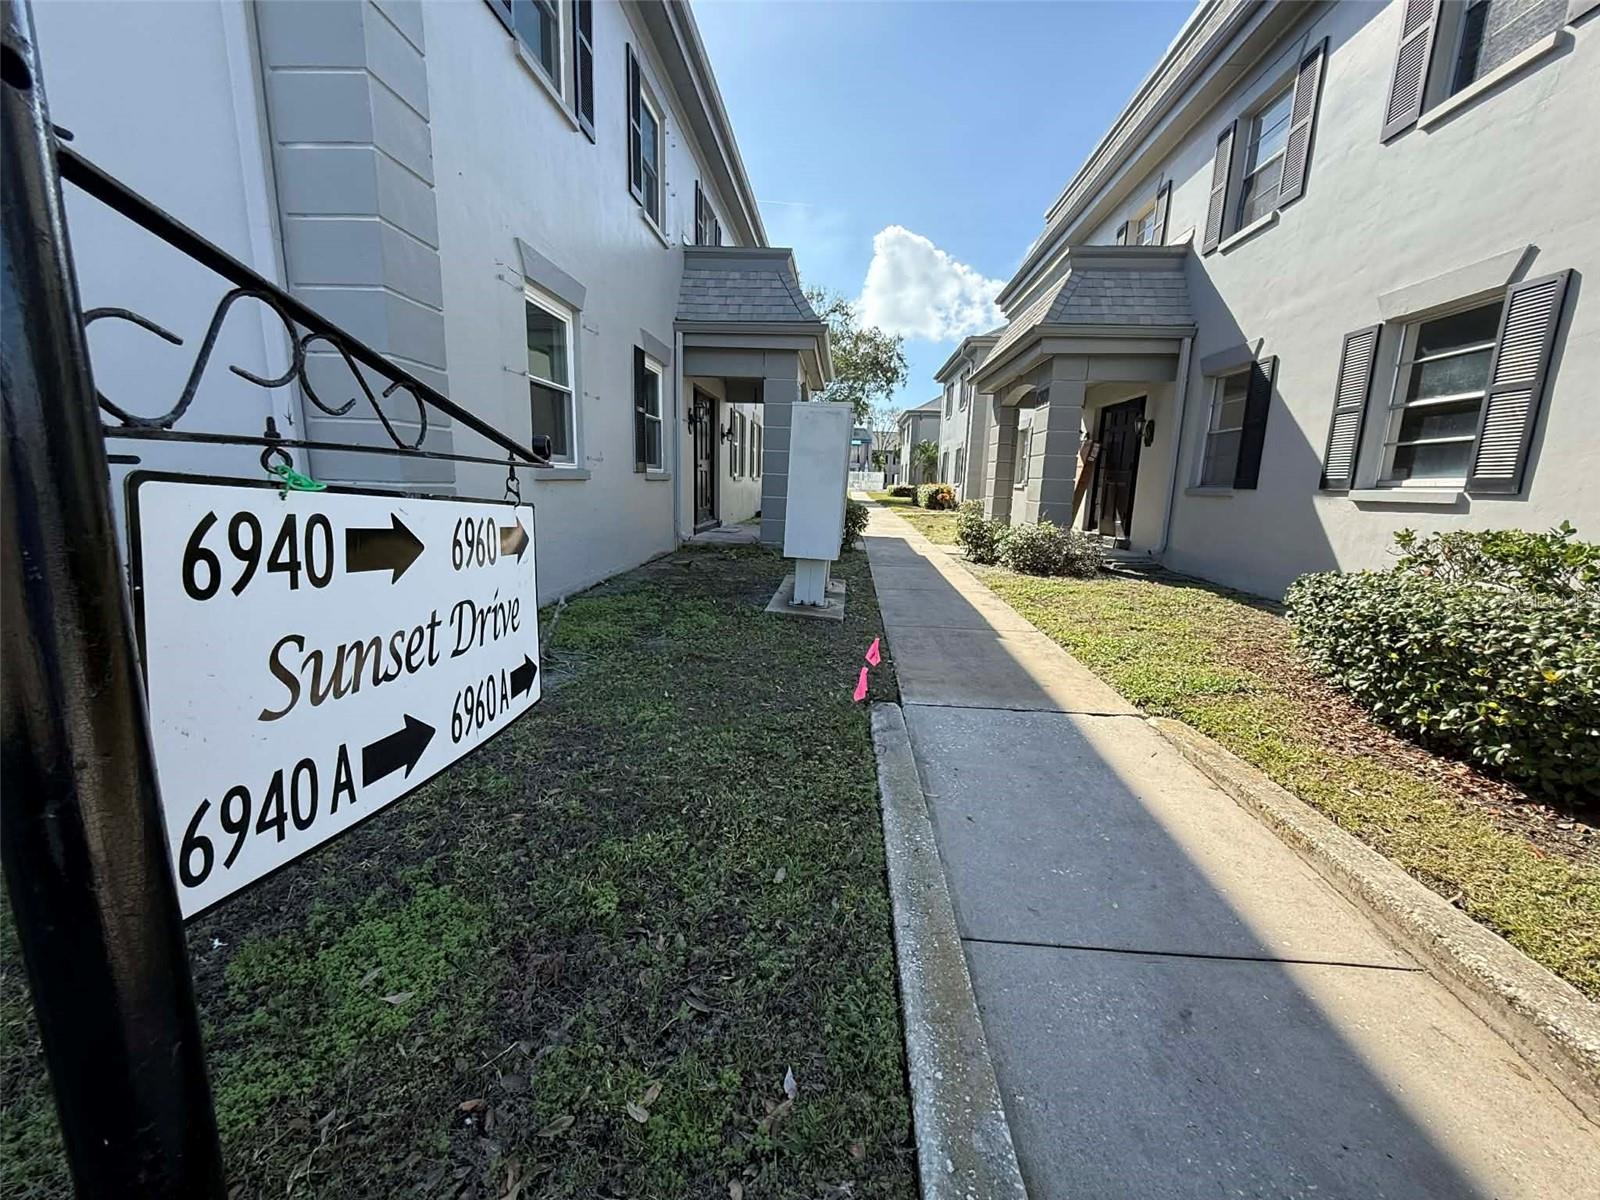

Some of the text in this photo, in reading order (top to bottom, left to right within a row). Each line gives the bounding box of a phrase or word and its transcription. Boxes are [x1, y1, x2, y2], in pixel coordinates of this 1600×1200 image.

[182, 511, 334, 601] 6940
[451, 516, 497, 571] 6960
[257, 588, 521, 721] Sunset Drive
[451, 668, 510, 744] 6960 A
[178, 743, 358, 888] 6940 A
